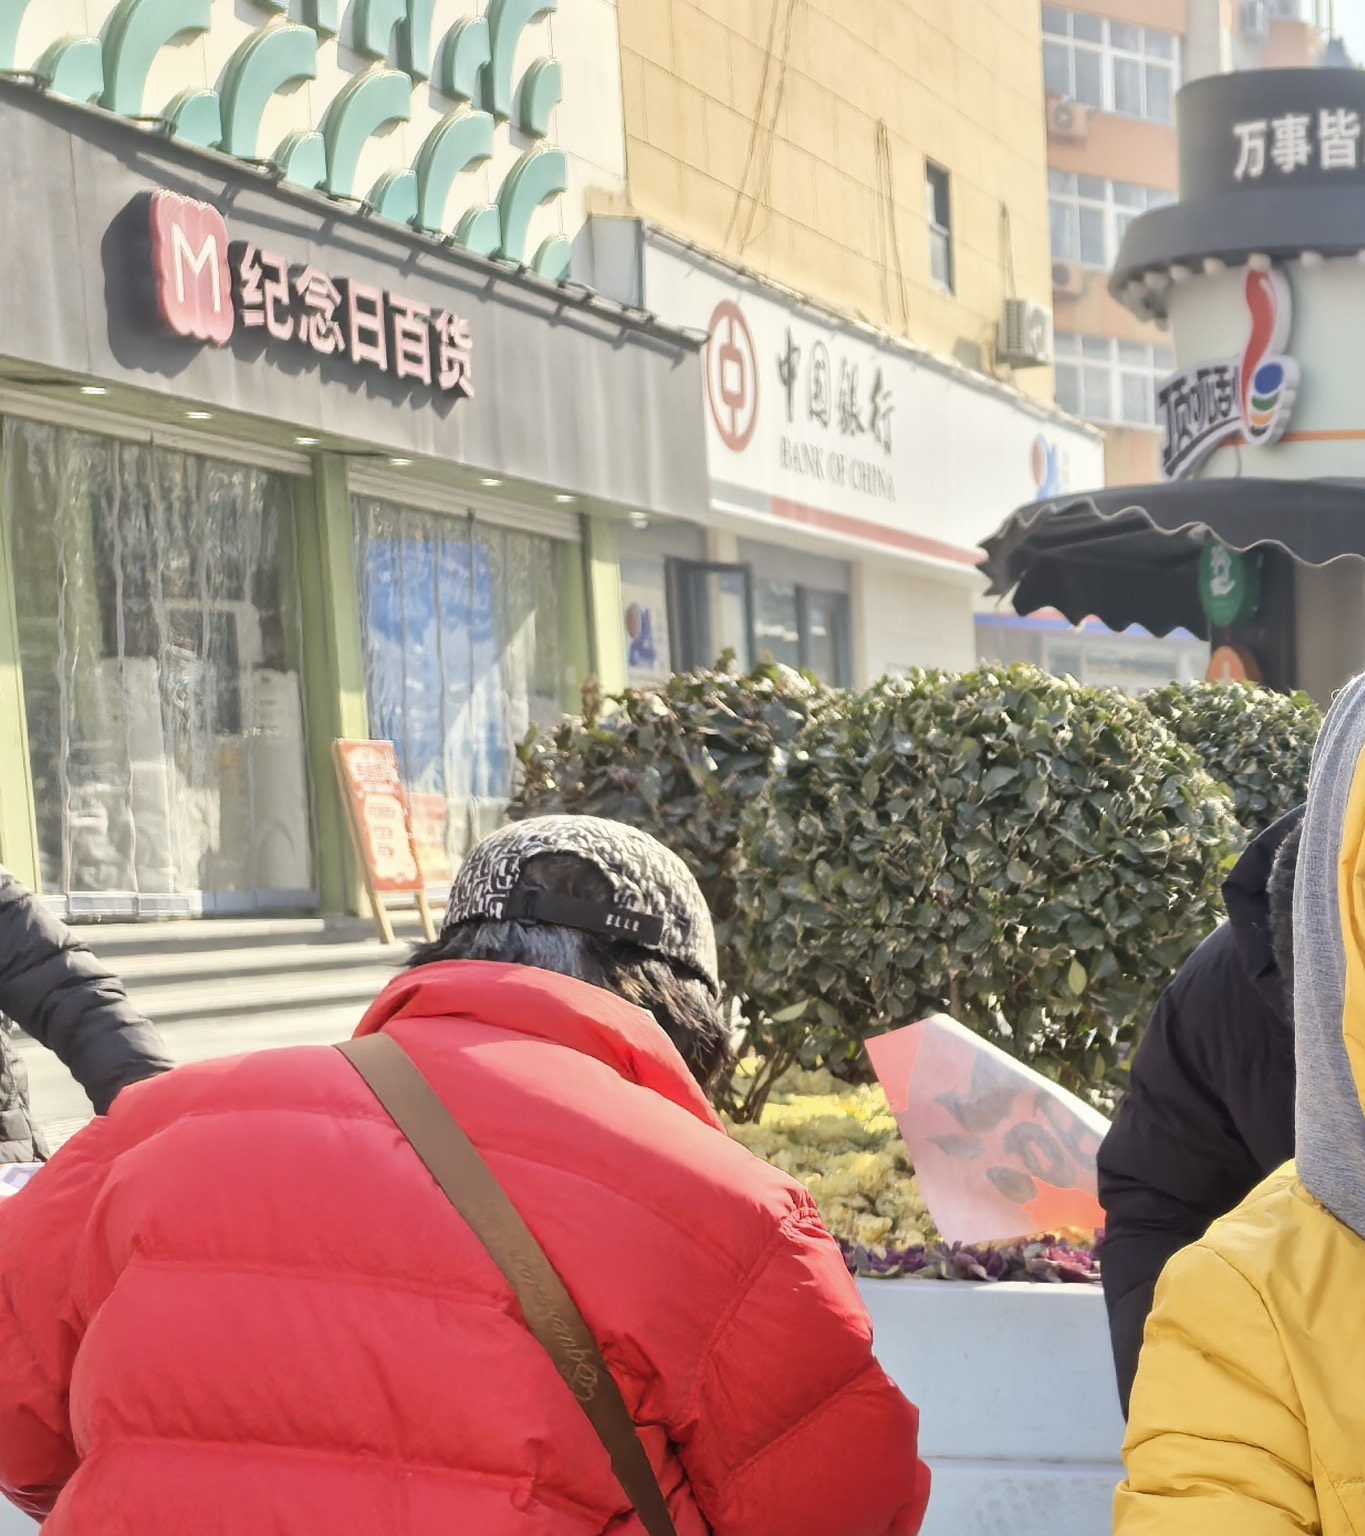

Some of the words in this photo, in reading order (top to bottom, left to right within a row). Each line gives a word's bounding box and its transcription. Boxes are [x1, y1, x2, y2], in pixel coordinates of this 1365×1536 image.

[171, 222, 222, 313] M
[238, 242, 475, 399] 纪念日百货
[774, 325, 896, 456] 中国银行
[779, 435, 825, 481] BANK
[826, 451, 847, 487] OF
[851, 458, 897, 501] CHINA
[605, 913, 640, 932] ELLE
